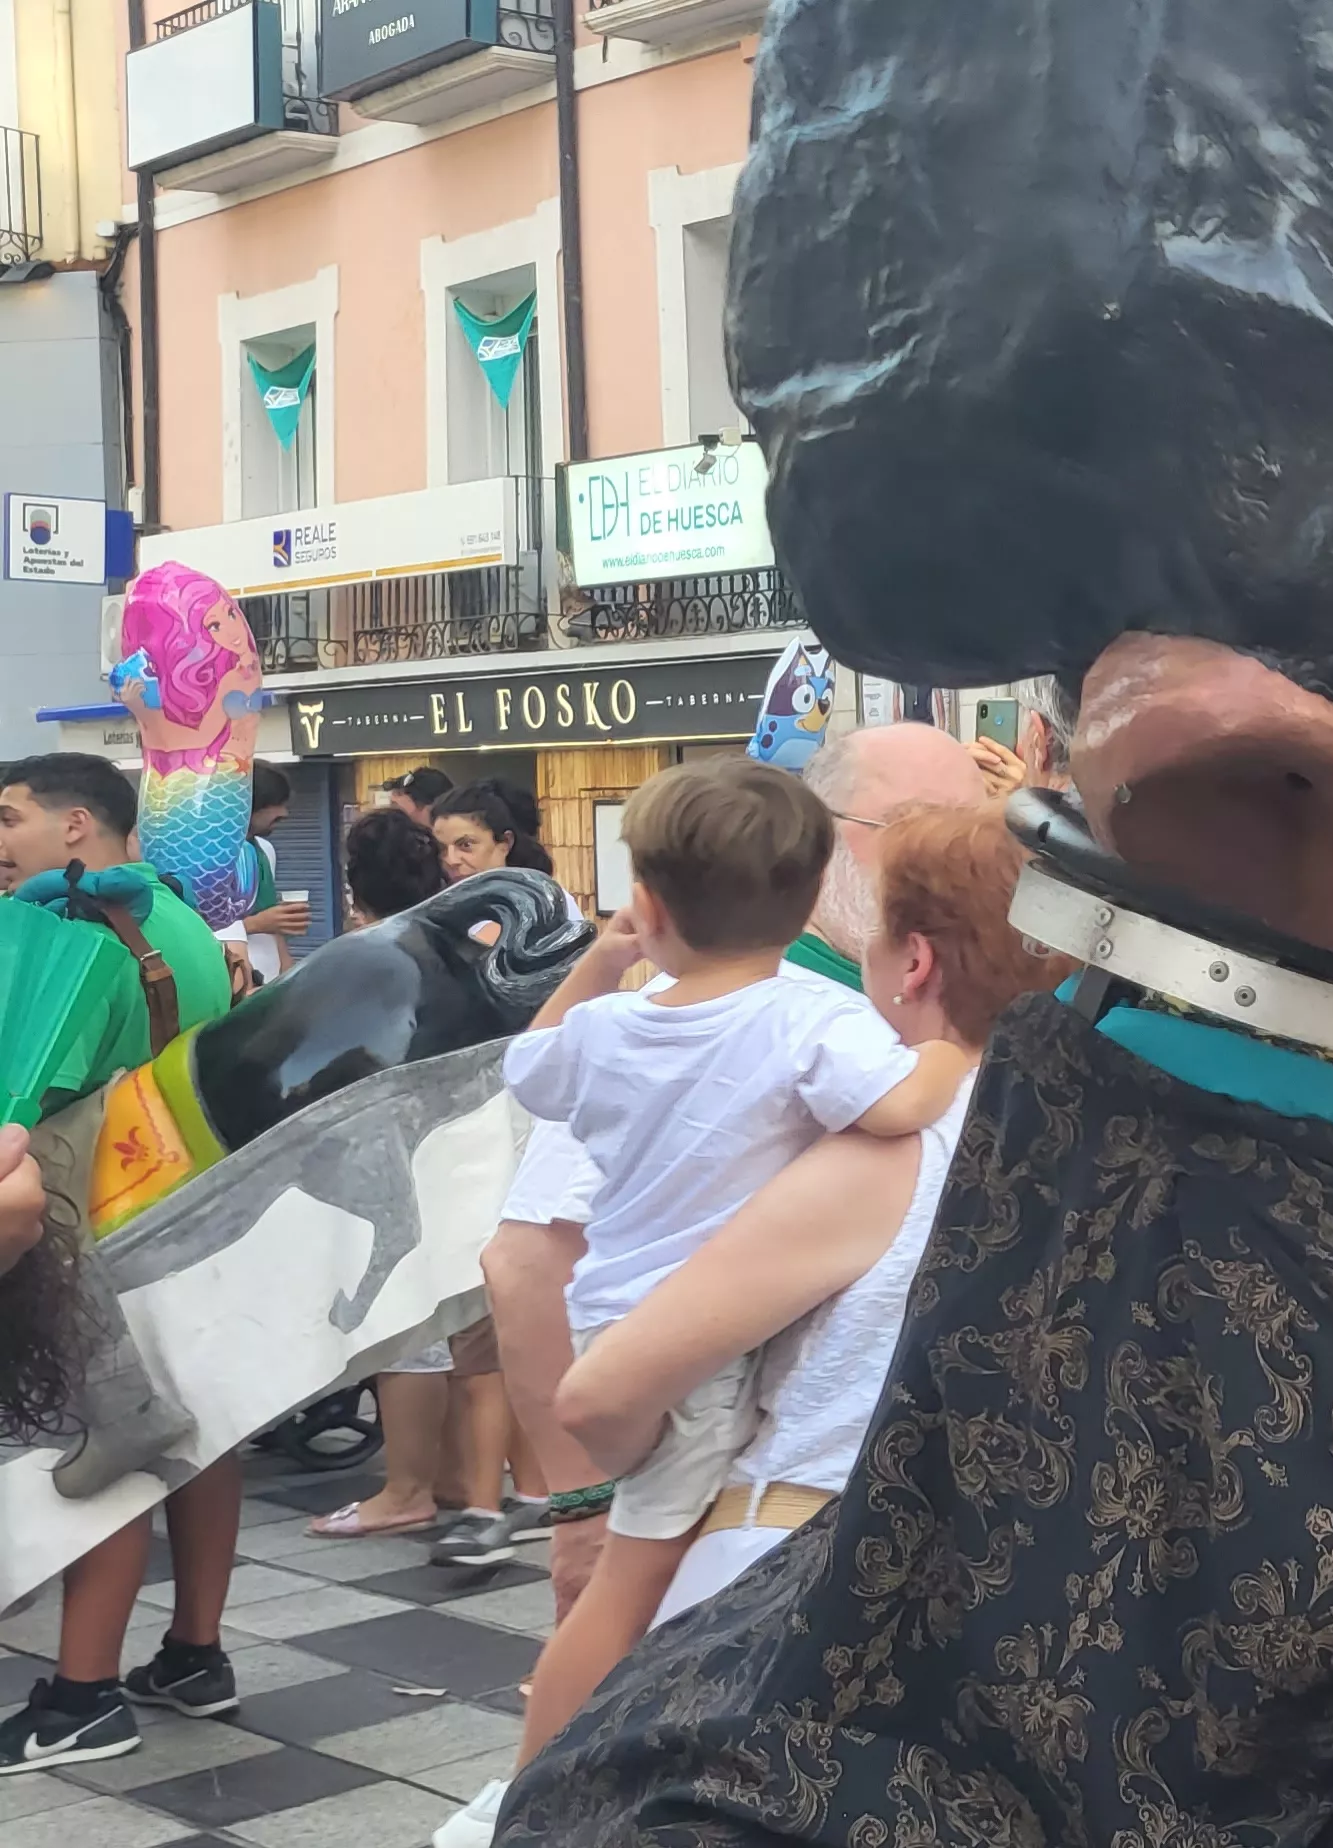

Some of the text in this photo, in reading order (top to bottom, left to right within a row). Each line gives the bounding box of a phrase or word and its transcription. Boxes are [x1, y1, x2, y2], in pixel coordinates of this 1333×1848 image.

[368, 14, 415, 45] ABOGADA
[638, 467, 663, 496] EL
[640, 500, 743, 536] DE HUESCA
[295, 522, 337, 547] REALE
[23, 556, 67, 567] Apuestas
[294, 546, 337, 564] SEGUROS
[22, 566, 55, 575] Estado
[430, 692, 473, 734] EL
[496, 679, 637, 731] FOSKO
[665, 693, 746, 707] TABERNA
